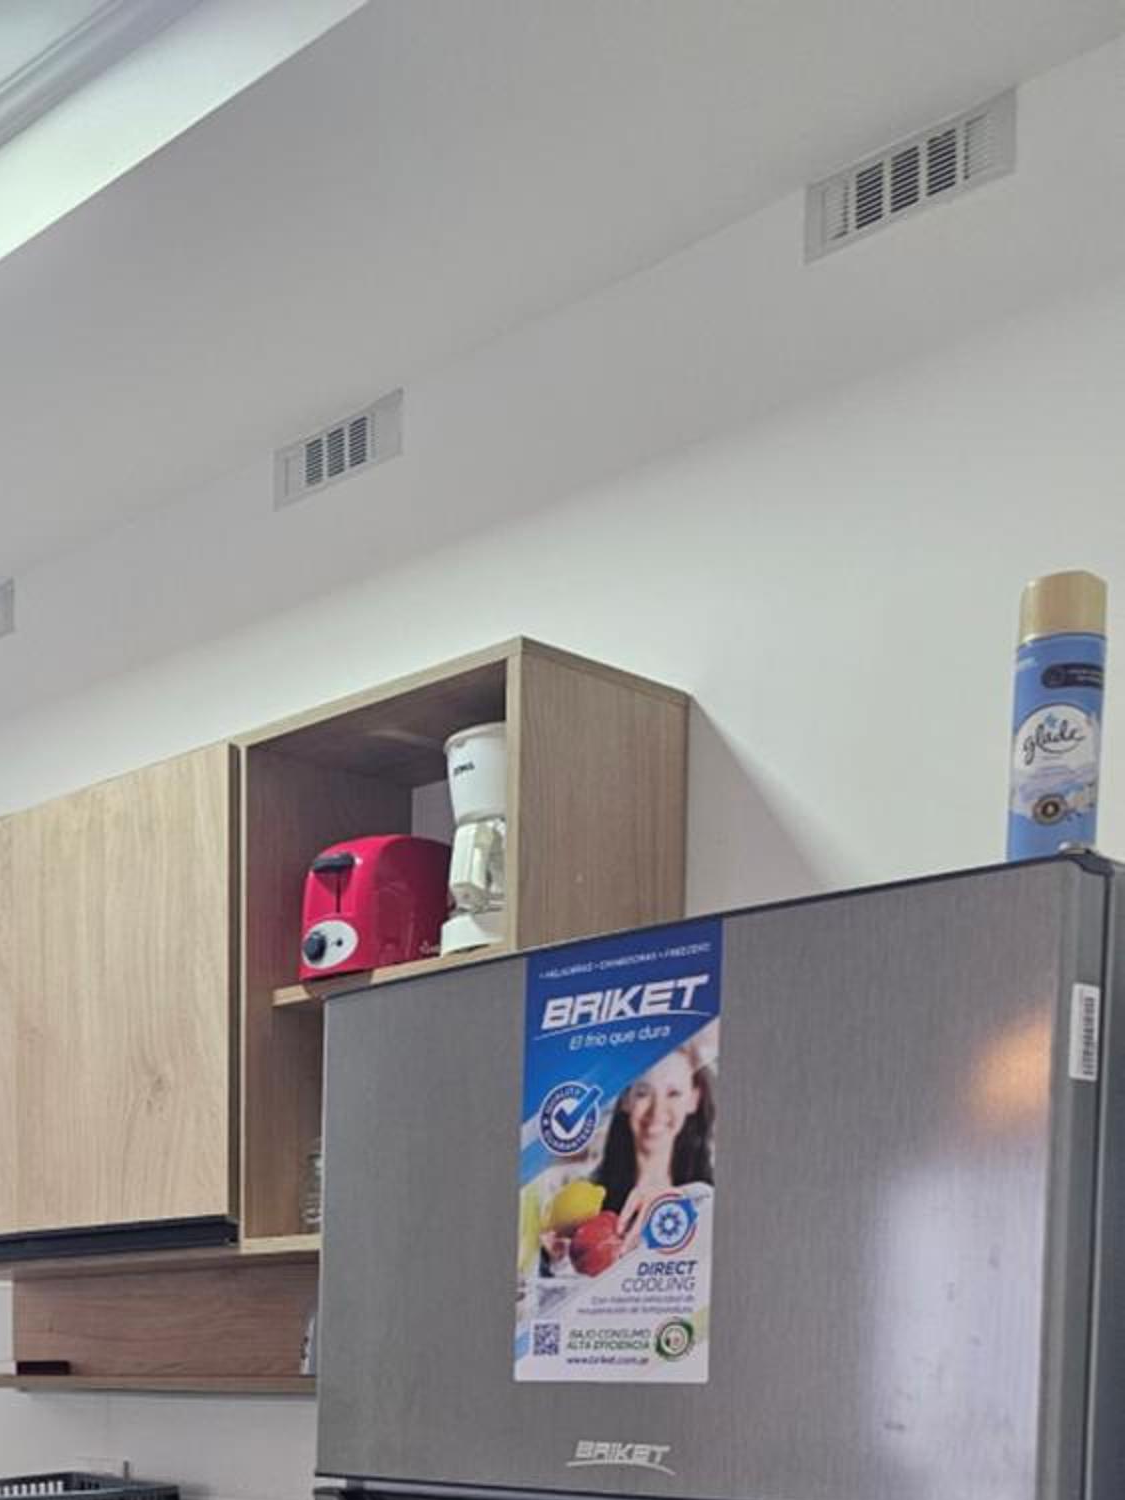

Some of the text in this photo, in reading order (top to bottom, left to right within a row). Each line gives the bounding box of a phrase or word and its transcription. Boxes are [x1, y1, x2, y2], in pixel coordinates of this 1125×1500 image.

[1023, 719, 1086, 766] glade
[541, 974, 710, 1030] BRIKET
[609, 1029, 636, 1046] que
[638, 1024, 671, 1041] dura
[637, 1260, 697, 1276] DIRECT
[621, 1277, 696, 1293] COOLING
[598, 1327, 651, 1339] CONSUMO
[575, 1440, 671, 1465] BRIKET
